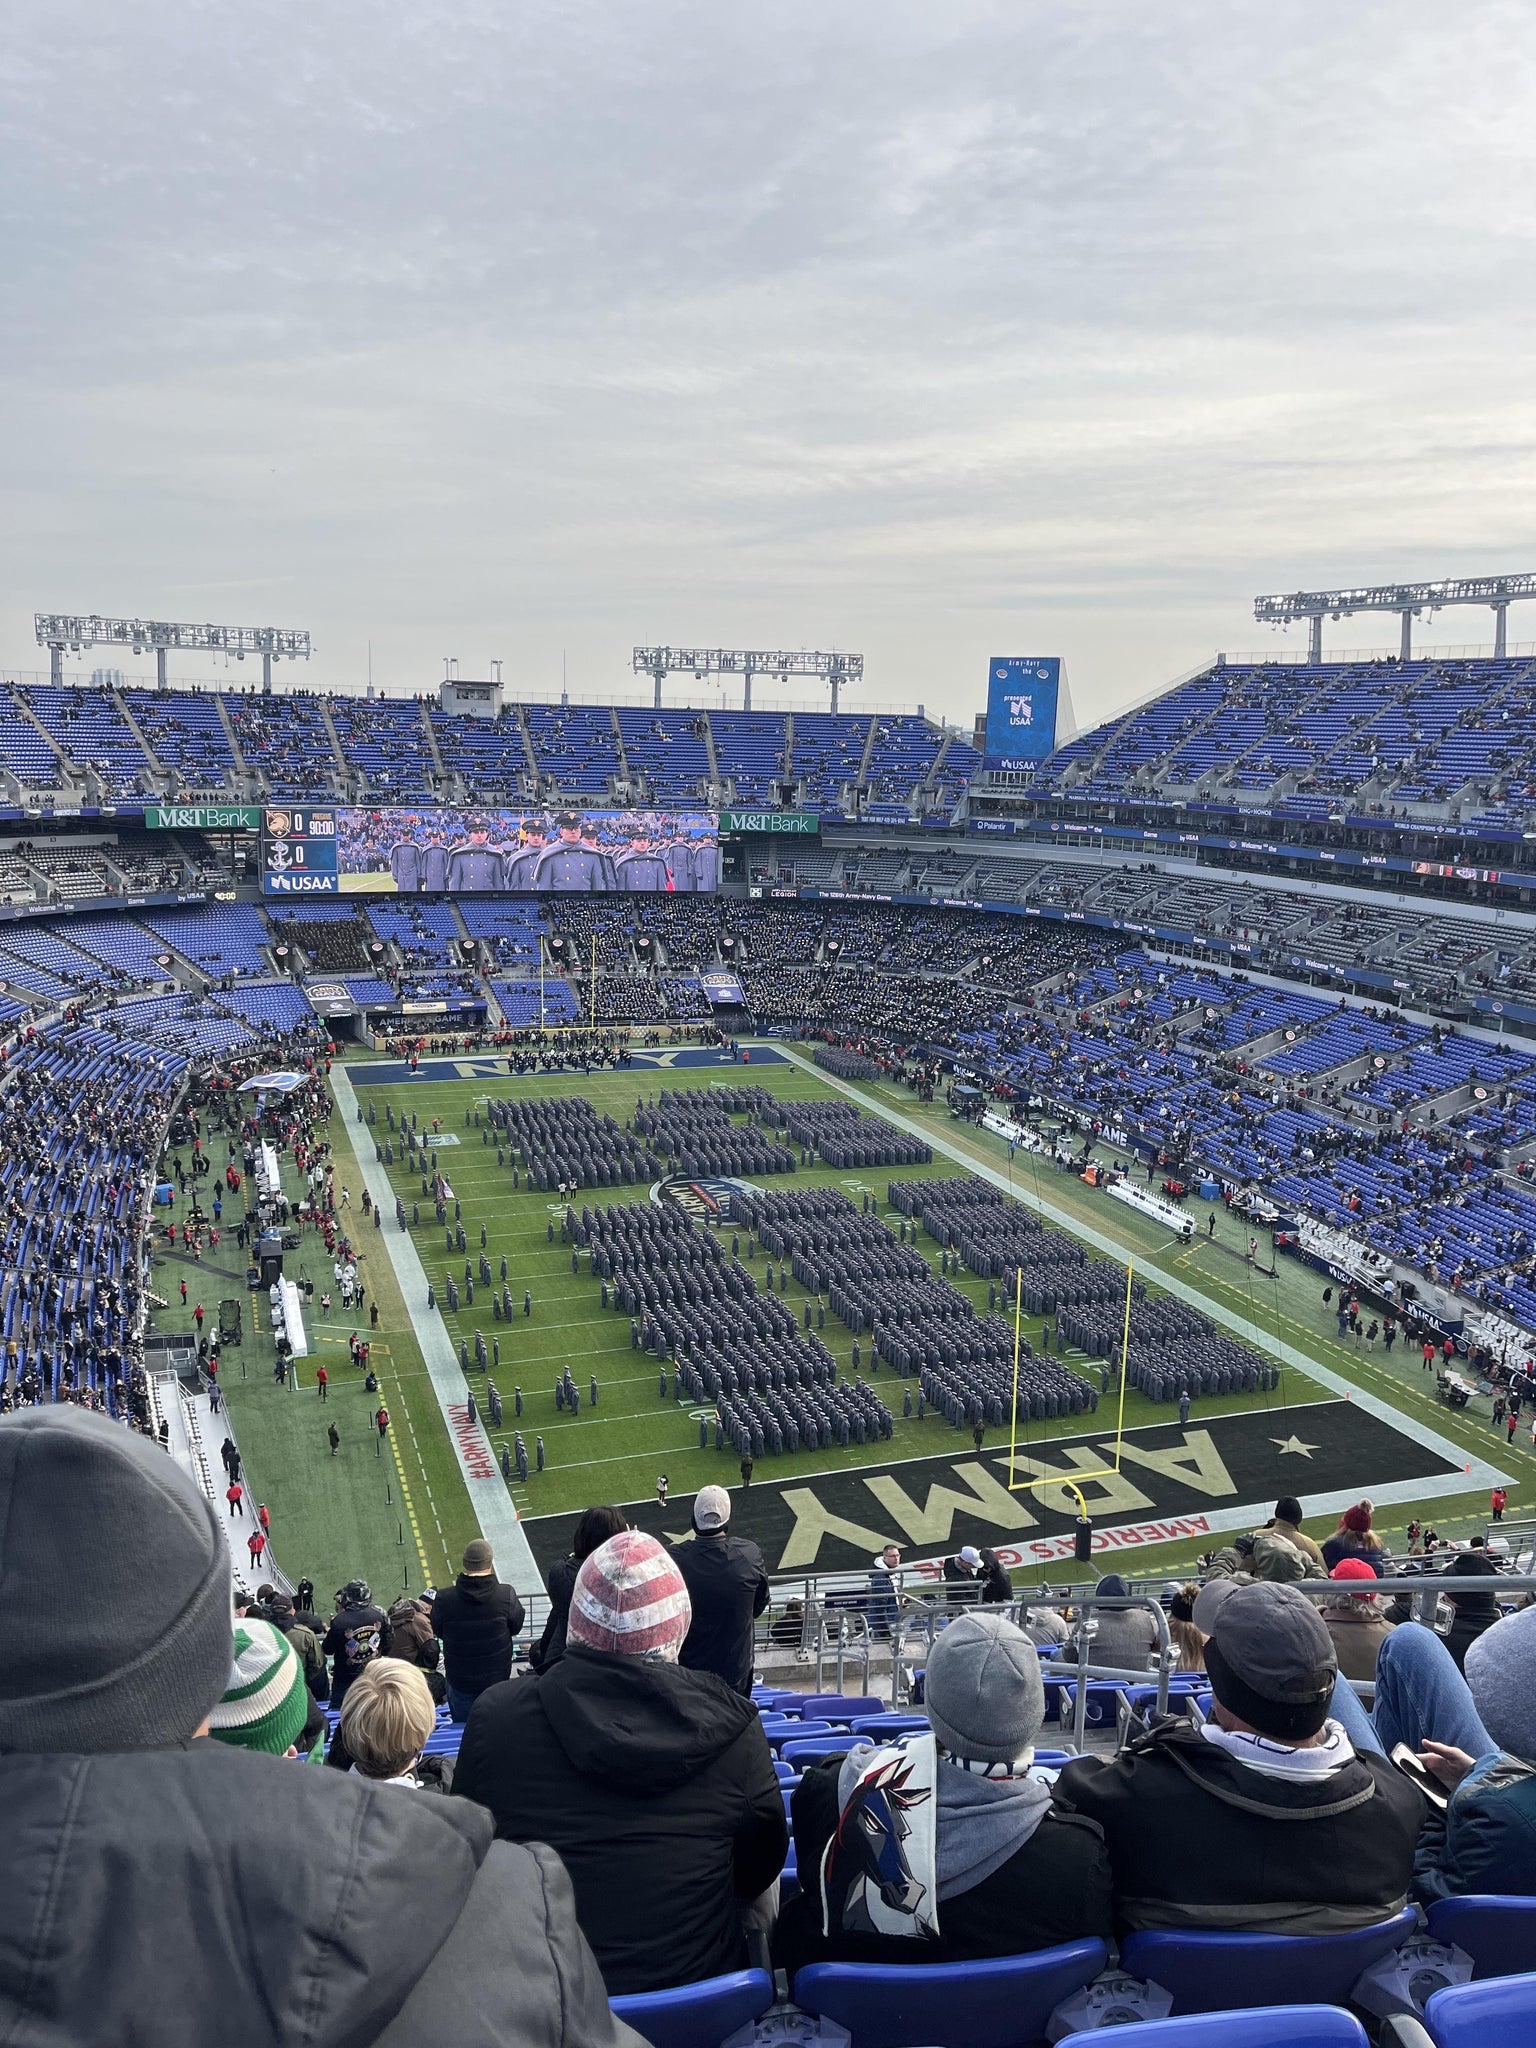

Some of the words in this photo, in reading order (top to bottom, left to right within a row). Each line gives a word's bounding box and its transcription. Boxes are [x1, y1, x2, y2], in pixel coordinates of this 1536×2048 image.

[1010, 717, 1031, 726] USAA
[1012, 761, 1035, 770] USAA
[157, 809, 206, 827] M&T
[207, 809, 250, 827] Bank
[1253, 808, 1272, 816] HONOR
[295, 813, 303, 832] 0
[309, 821, 335, 835] 90:00
[730, 813, 771, 831] M&T
[771, 815, 809, 833] Bank
[983, 821, 1006, 831] Palantir
[1394, 822, 1410, 830] WORLD
[1410, 824, 1436, 832] CHAMPIONS
[1064, 824, 1087, 832] Welcome
[1179, 834, 1186, 842] by
[1186, 833, 1199, 841] USAA
[295, 845, 304, 864] 0
[1241, 842, 1262, 850] Welcome
[1362, 857, 1370, 865] by
[1370, 856, 1387, 864] USAA
[291, 877, 332, 890] USAA
[28, 904, 56, 913] Welcome
[64, 902, 74, 911] the
[127, 897, 146, 905] Game
[177, 894, 186, 902] by
[186, 891, 205, 900] USAA
[845, 892, 876, 900] Army-Navy
[944, 898, 967, 906] Welcome
[1070, 912, 1084, 920] USAA
[1230, 943, 1237, 951] by
[1305, 958, 1328, 971] Welcome
[1335, 965, 1345, 975] the
[434, 1014, 463, 1023] GAME
[453, 1052, 681, 1077] NY
[447, 1404, 495, 1479] #ARMYNAVY
[778, 1429, 1240, 1569] ARMY
[914, 1551, 1022, 1580] GE
[357, 1631, 371, 1639] ARMY
